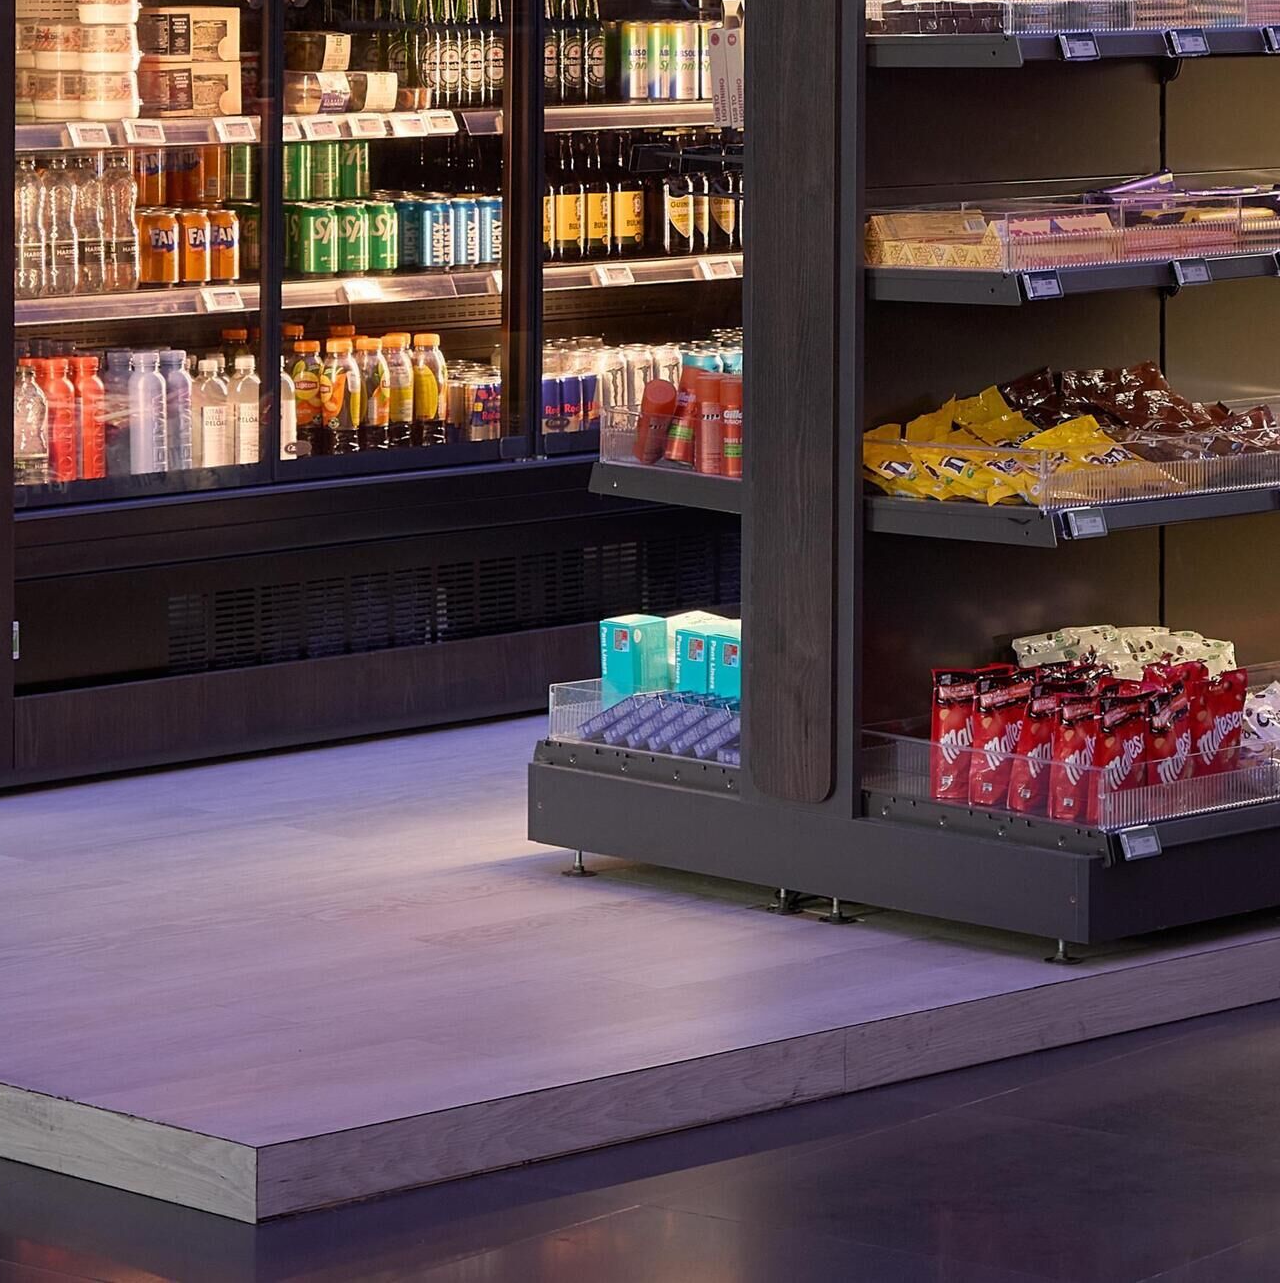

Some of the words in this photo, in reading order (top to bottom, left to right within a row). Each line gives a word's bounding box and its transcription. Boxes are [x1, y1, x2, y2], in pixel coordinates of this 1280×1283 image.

[432, 222, 444, 263] LUCKY
[467, 221, 478, 262] LUCKY
[492, 219, 503, 259] LUCKY
[295, 382, 318, 390] Lipton
